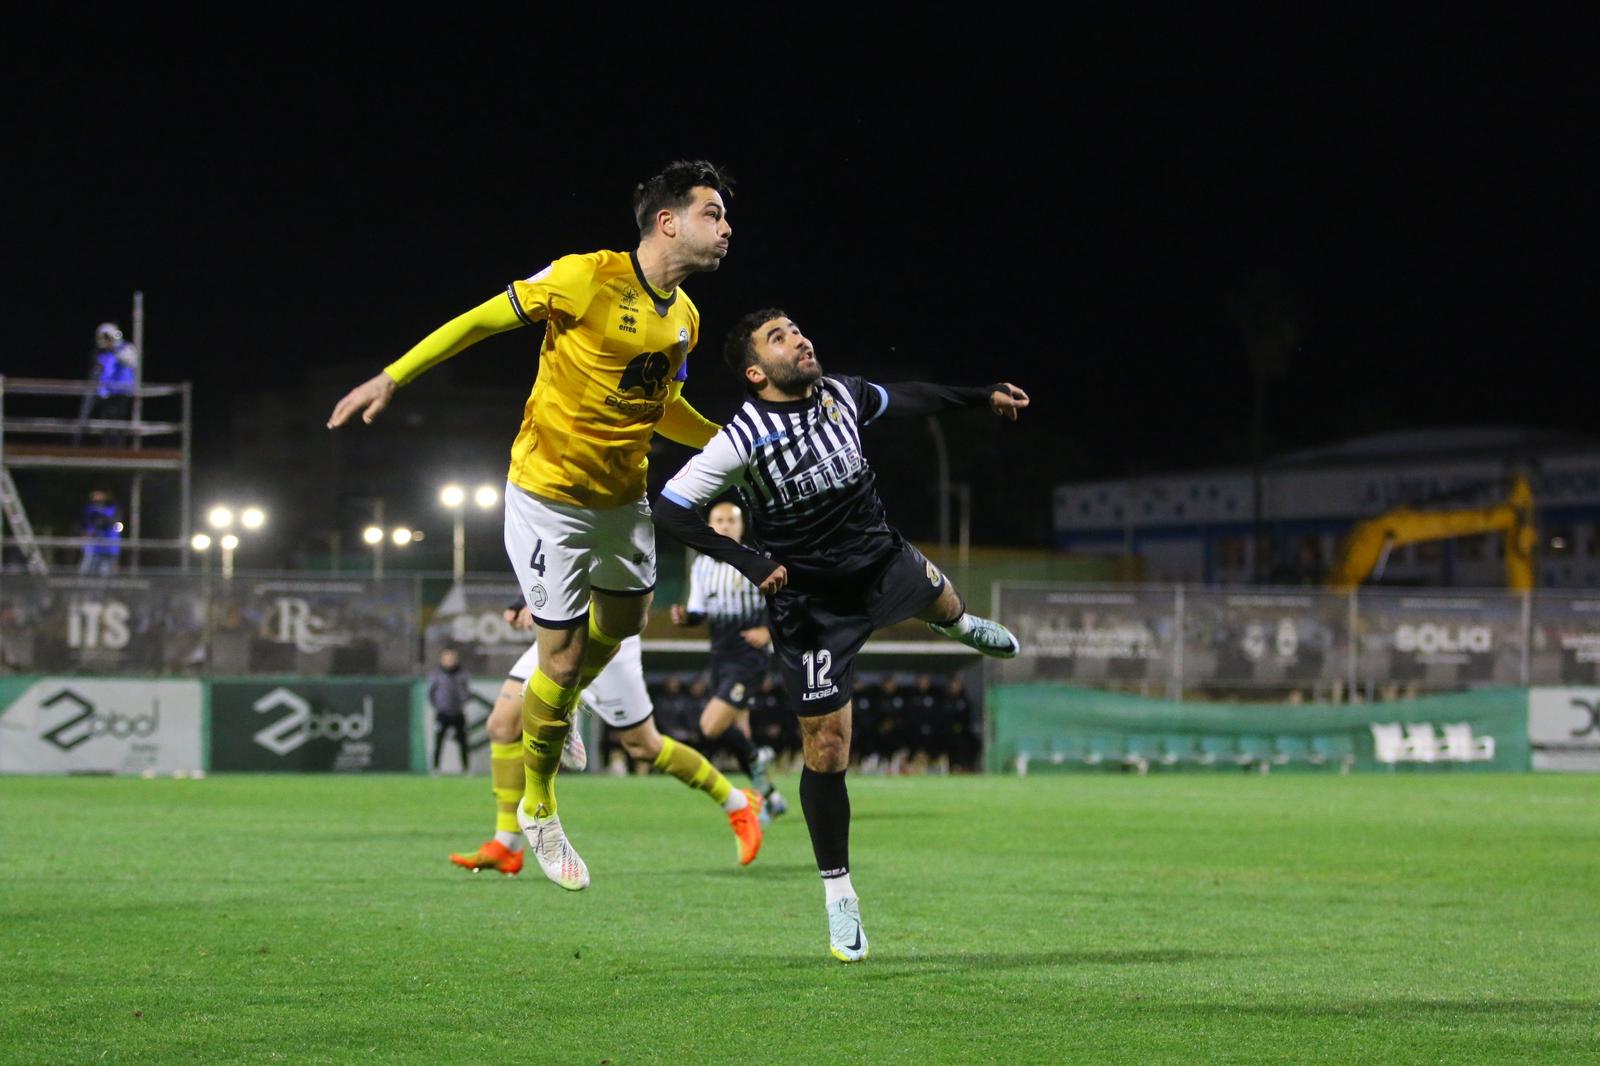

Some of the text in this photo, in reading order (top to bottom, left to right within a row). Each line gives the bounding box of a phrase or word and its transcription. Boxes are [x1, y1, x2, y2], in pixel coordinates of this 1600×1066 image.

[779, 446, 860, 509] LOTUS
[530, 538, 546, 577] 4
[802, 648, 832, 689] 12
[802, 685, 838, 701] LEGEA
